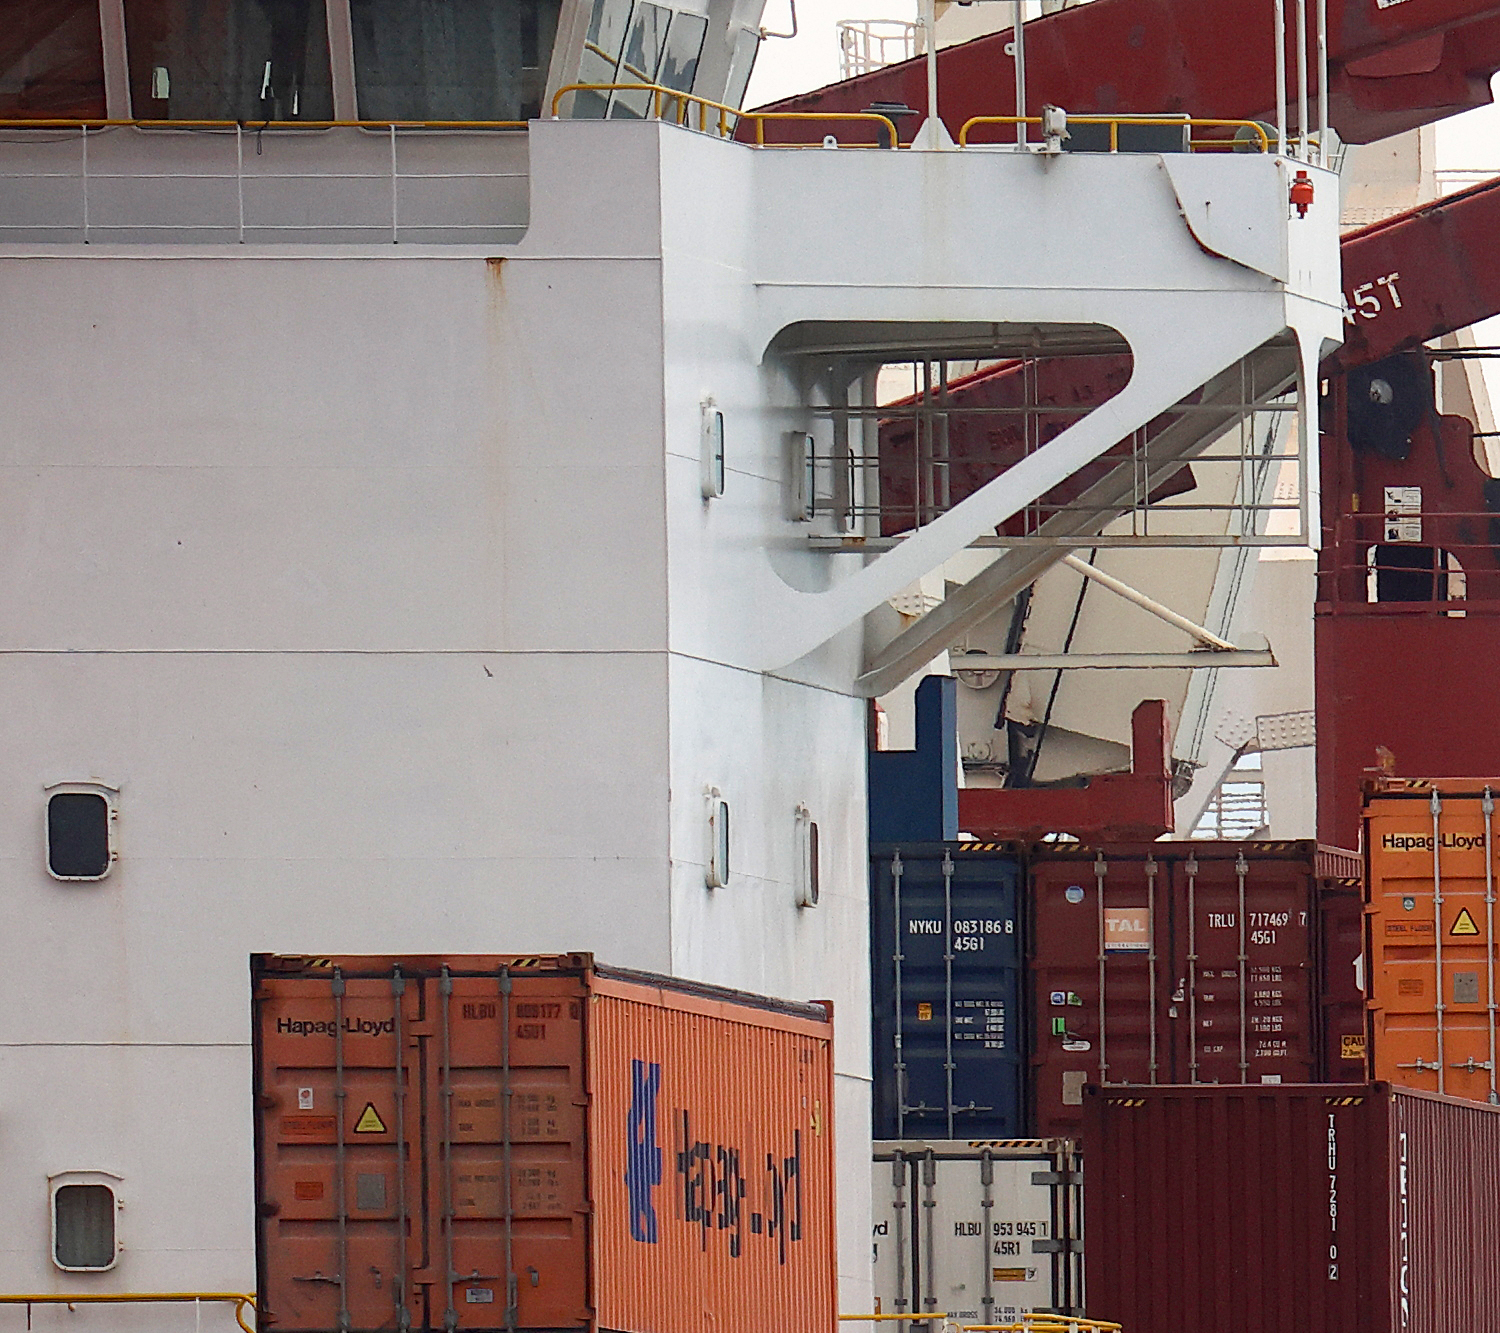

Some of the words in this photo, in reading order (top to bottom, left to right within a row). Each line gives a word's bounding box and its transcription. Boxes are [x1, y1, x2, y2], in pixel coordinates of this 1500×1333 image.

[1382, 833, 1486, 852] Hapag-Lloyd
[908, 919, 943, 935] NYKU
[953, 919, 1002, 935] 083186
[1004, 919, 1014, 935] 8
[1104, 918, 1147, 933] TAL
[1207, 912, 1236, 929] TRLU
[1249, 912, 1289, 928] 717469
[953, 936, 985, 951] 45G1
[1250, 930, 1277, 945] 45G1
[276, 1017, 396, 1038] Hapag-Lloyd
[1327, 1113, 1337, 1171] TRHU
[954, 1222, 983, 1237] HLBU
[992, 1222, 1014, 1236] 953
[1016, 1222, 1037, 1236] 945
[992, 1241, 1021, 1256] 45R1
